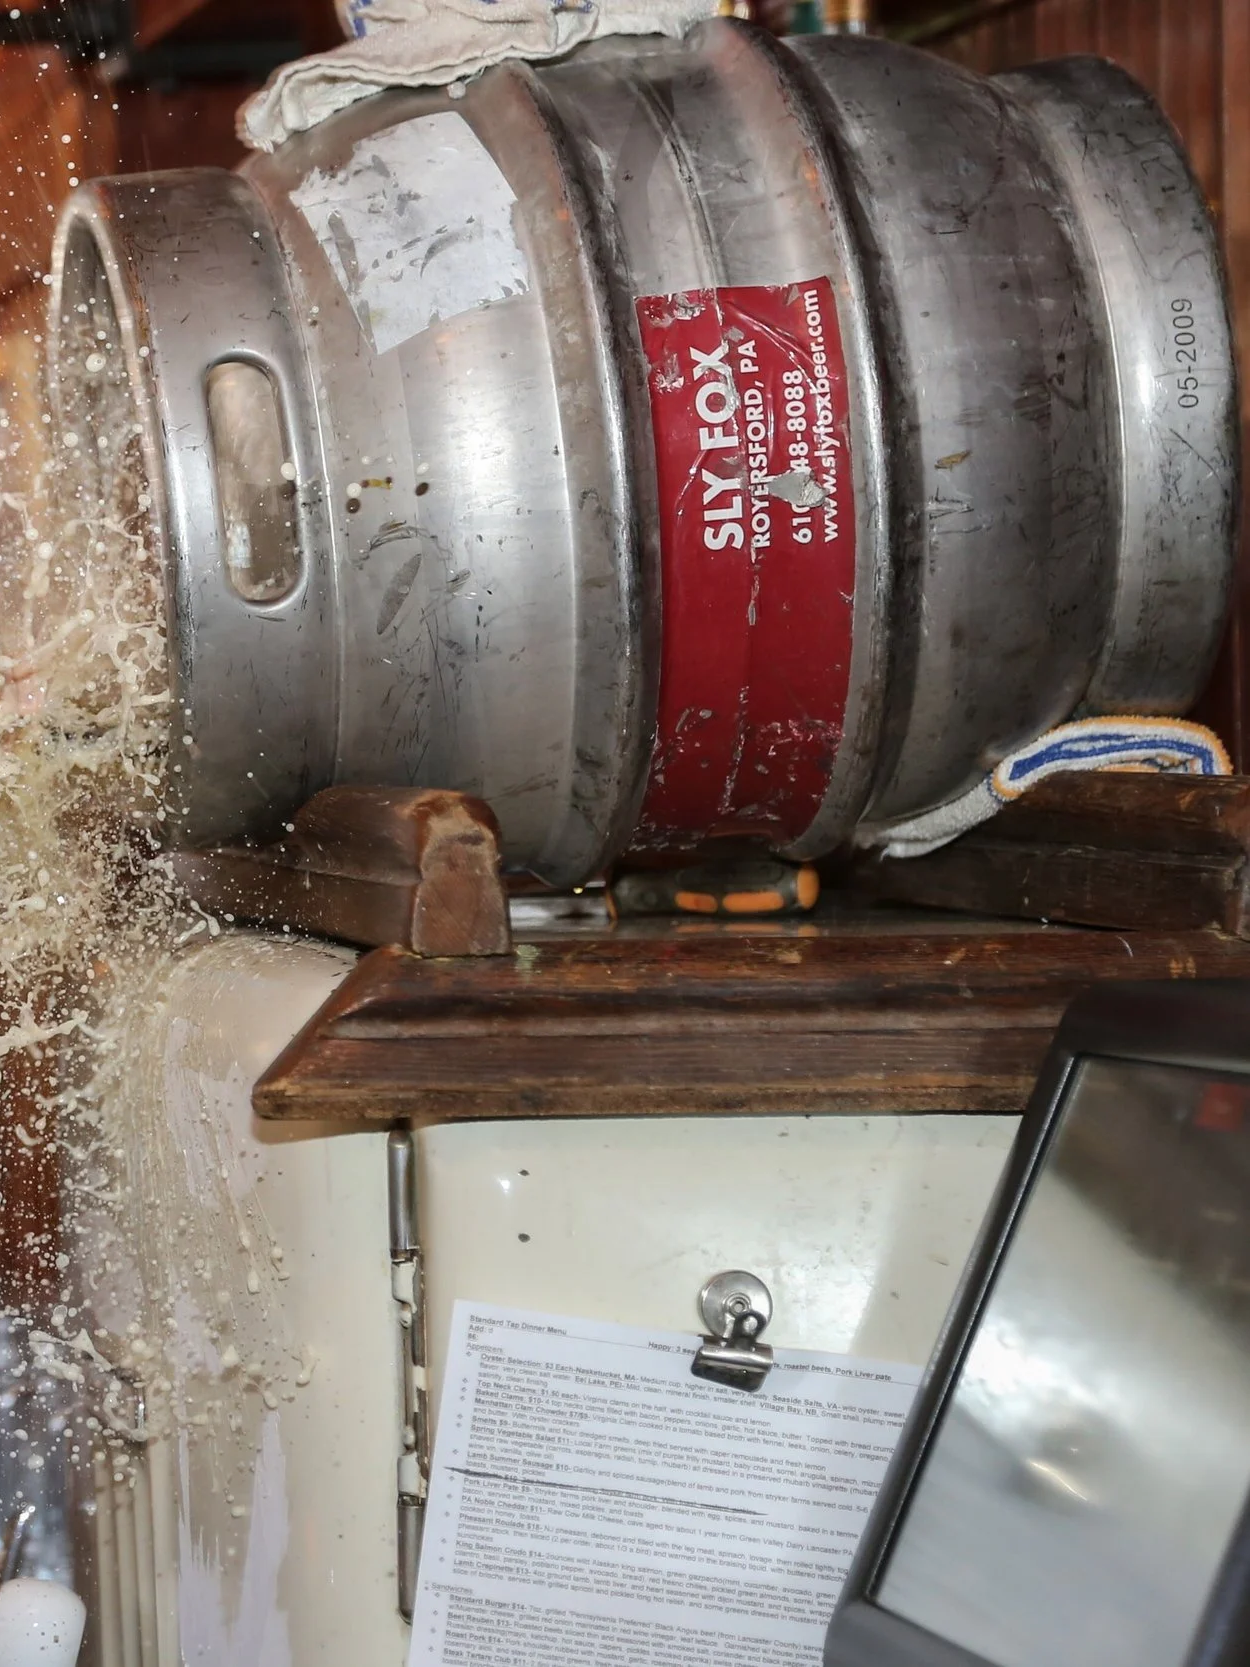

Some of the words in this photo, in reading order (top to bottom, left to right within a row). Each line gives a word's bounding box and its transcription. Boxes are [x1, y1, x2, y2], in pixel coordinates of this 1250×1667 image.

[690, 339, 741, 450] FOX
[738, 339, 759, 373] PA
[1171, 298, 1199, 408] 05-2009
[744, 380, 771, 548] ROYERSFORD,
[782, 369, 813, 544] 6148-8088
[804, 289, 841, 543] www.slyfoxbeer.com
[702, 468, 744, 550] SLY
